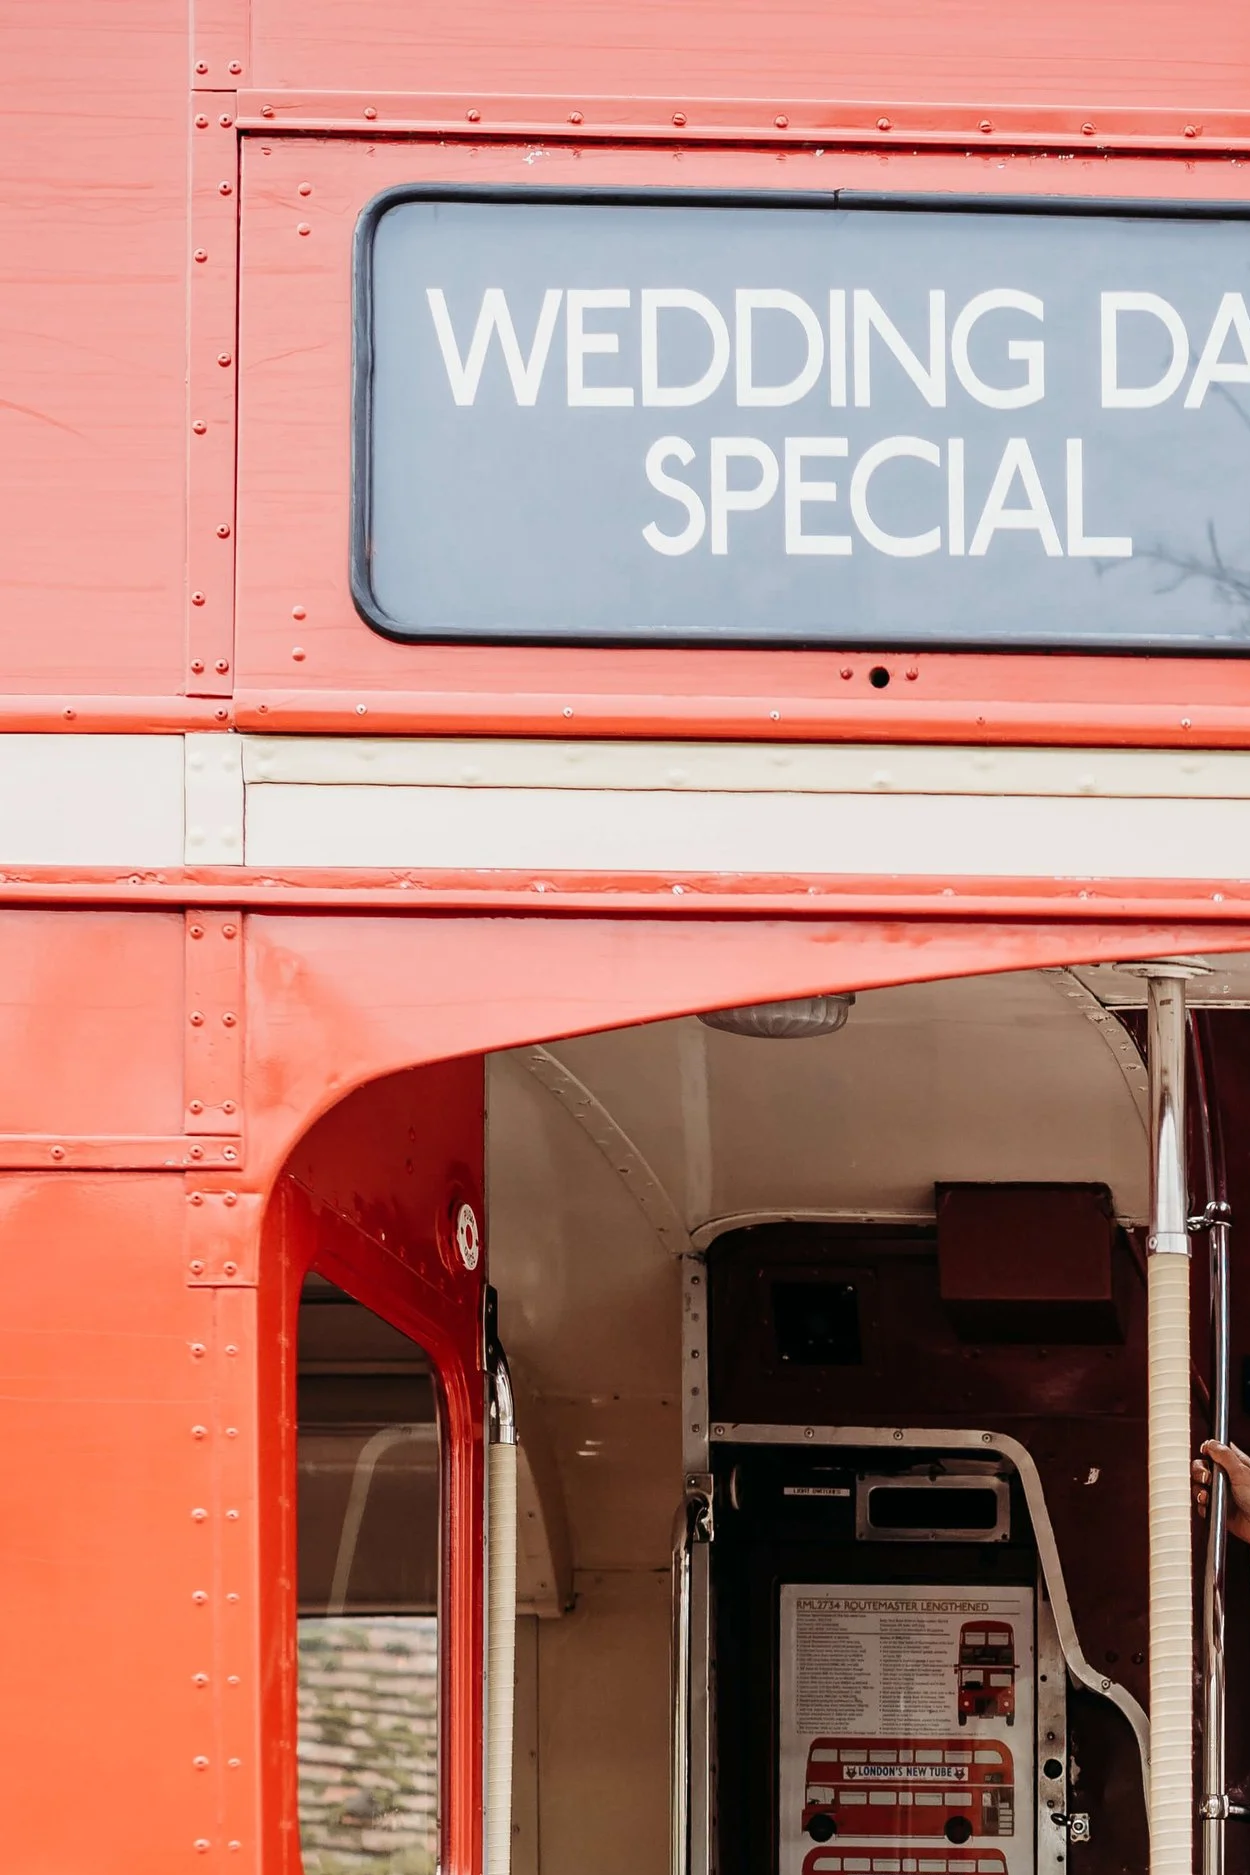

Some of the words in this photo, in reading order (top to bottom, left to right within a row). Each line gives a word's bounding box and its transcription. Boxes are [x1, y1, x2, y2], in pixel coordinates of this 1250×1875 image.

[427, 288, 1044, 409] WEDDING
[643, 436, 1132, 557] SPECIAL
[797, 1600, 841, 1611] RML2734
[844, 1601, 917, 1612] ROUTEMASTER
[920, 1602, 989, 1612] LENGTHENED
[858, 1766, 902, 1776] LONDON'S
[906, 1767, 926, 1776] NEW
[930, 1767, 952, 1777] TUBE
